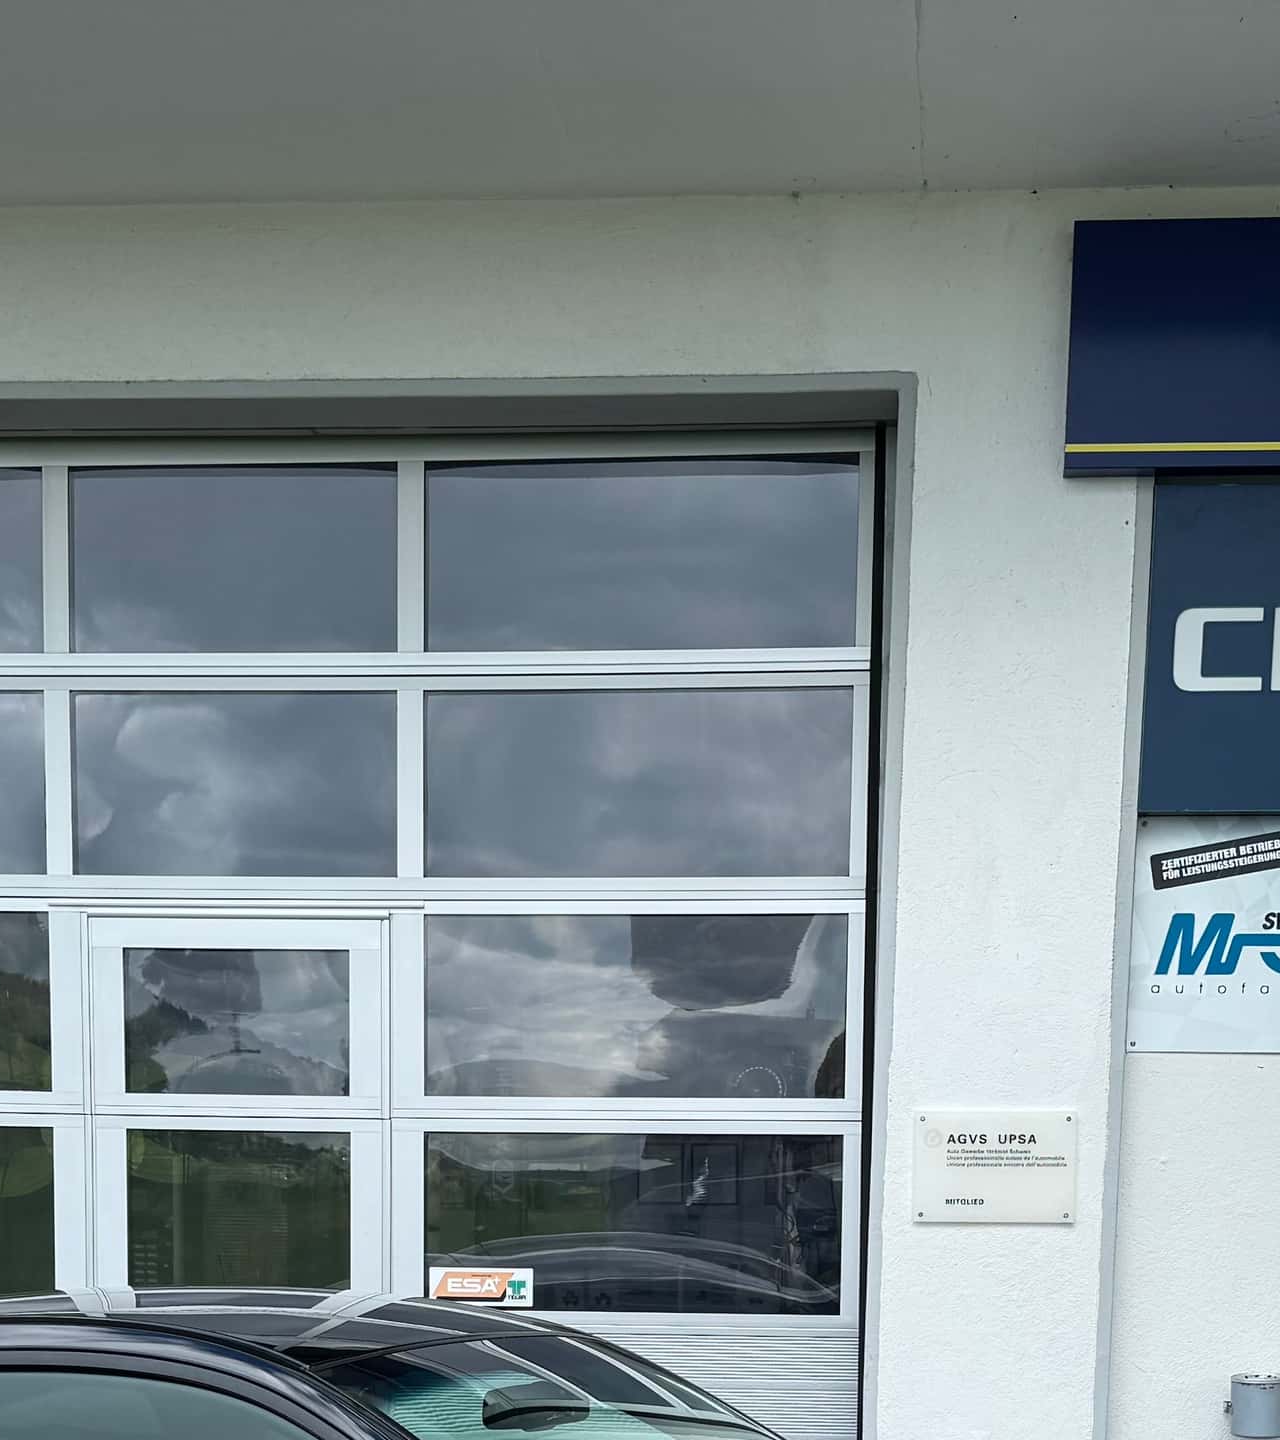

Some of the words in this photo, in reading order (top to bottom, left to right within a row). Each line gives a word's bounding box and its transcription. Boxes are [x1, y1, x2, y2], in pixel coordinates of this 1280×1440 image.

[1161, 847, 1237, 870] ZERTIFIZIERTER
[1239, 839, 1280, 856] BETRIEB
[1162, 868, 1180, 880] FÜR
[947, 1134, 988, 1145] AGVS
[998, 1134, 1037, 1145] UPSA
